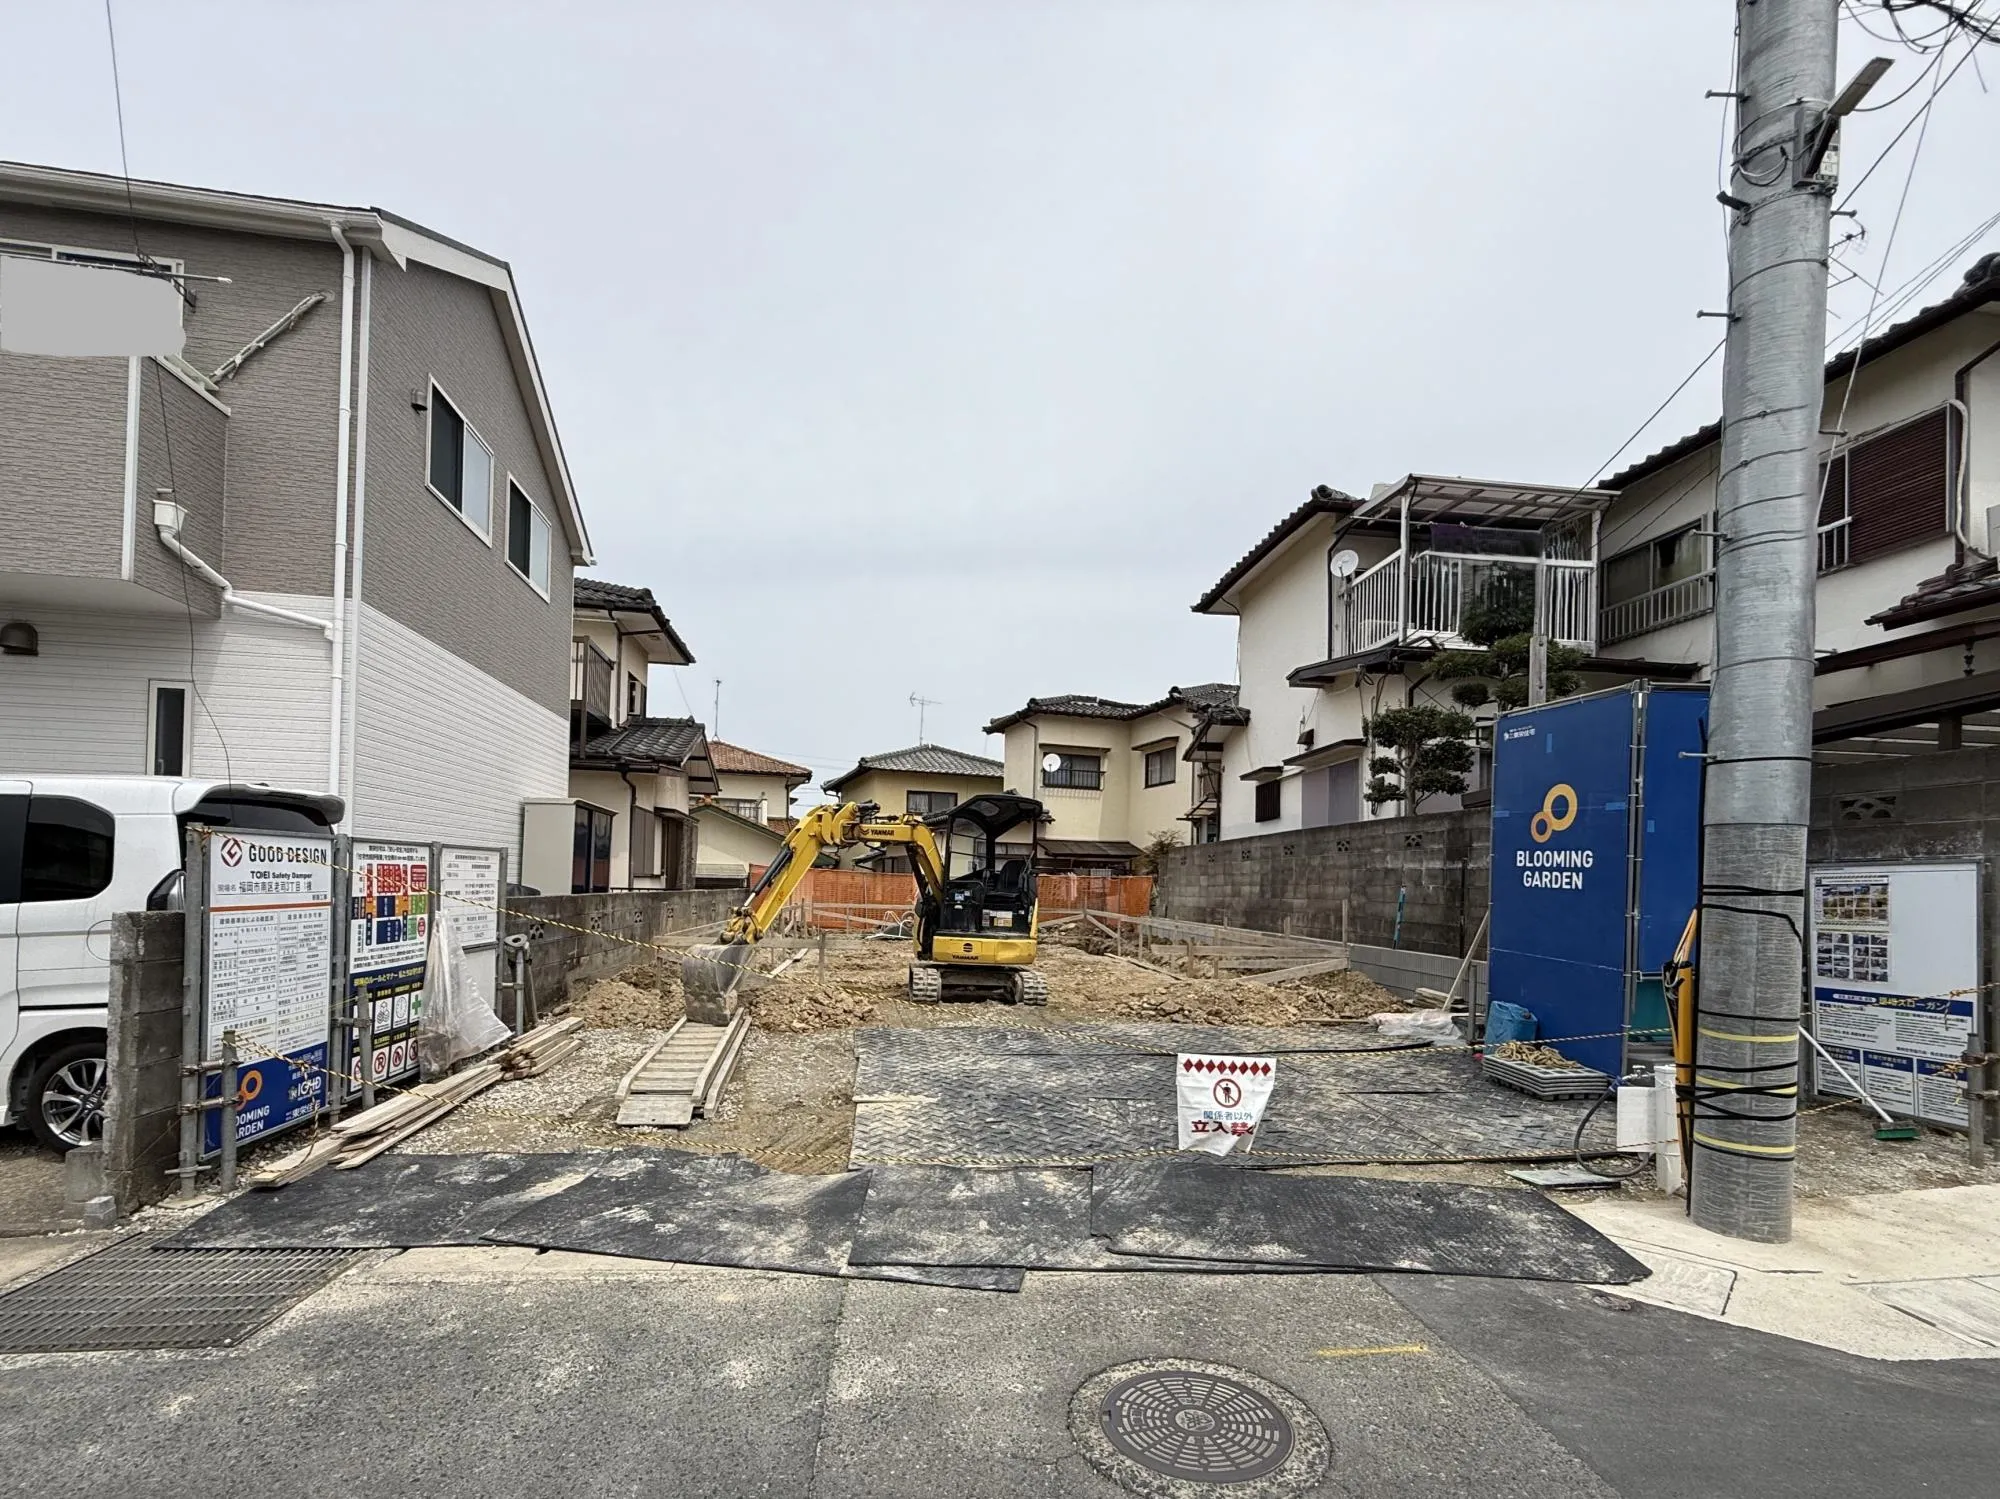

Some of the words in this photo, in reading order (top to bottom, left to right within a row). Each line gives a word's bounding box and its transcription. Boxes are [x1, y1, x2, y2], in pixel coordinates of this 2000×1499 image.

[249, 845, 283, 863] GOOD
[288, 847, 327, 864] DESIGN
[1516, 850, 1593, 868] BLOOMING
[250, 871, 270, 879] TOEI
[272, 872, 291, 880] Safety
[292, 872, 313, 880] Damper
[1523, 870, 1583, 890] GARDEN
[1203, 1110, 1253, 1120] 関係者以外
